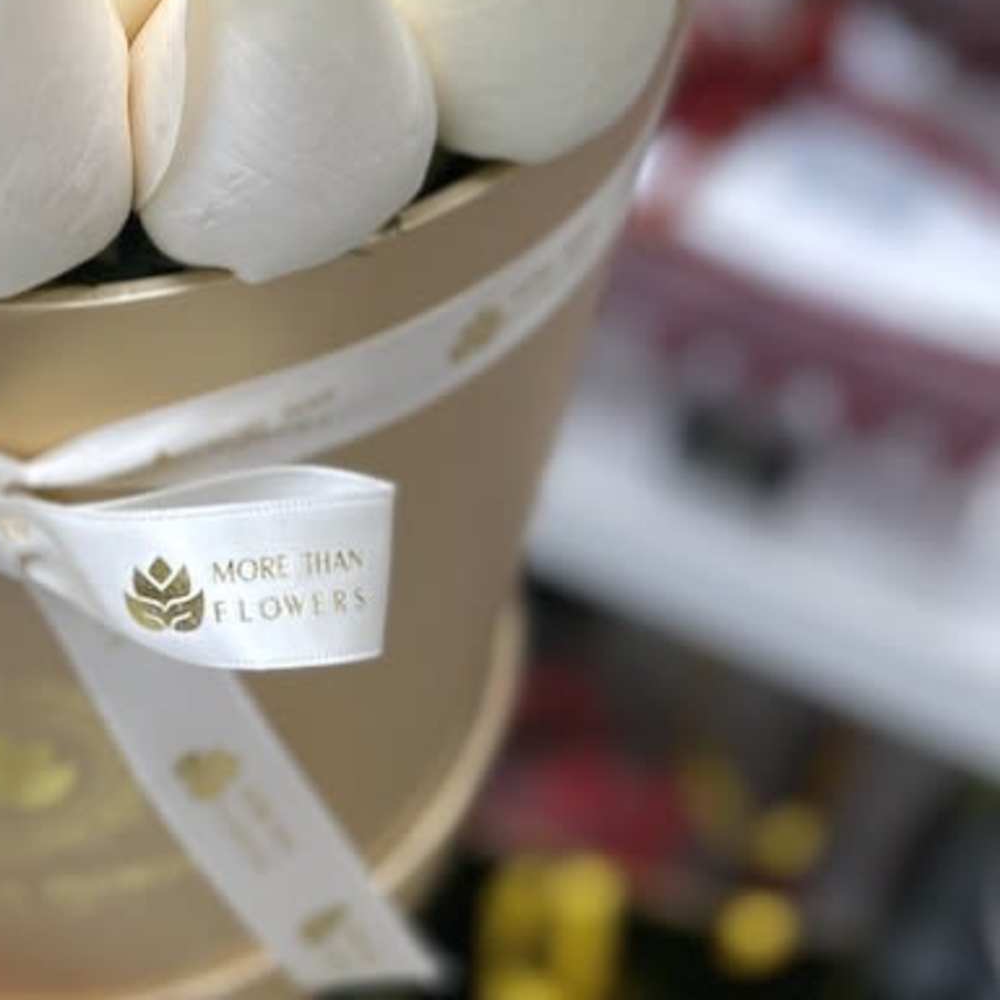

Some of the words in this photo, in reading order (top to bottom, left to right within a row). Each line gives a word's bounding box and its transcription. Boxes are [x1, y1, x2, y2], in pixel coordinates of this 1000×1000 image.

[212, 555, 288, 584] MORE
[302, 549, 364, 576] THAN
[214, 587, 367, 623] FLOWERS
